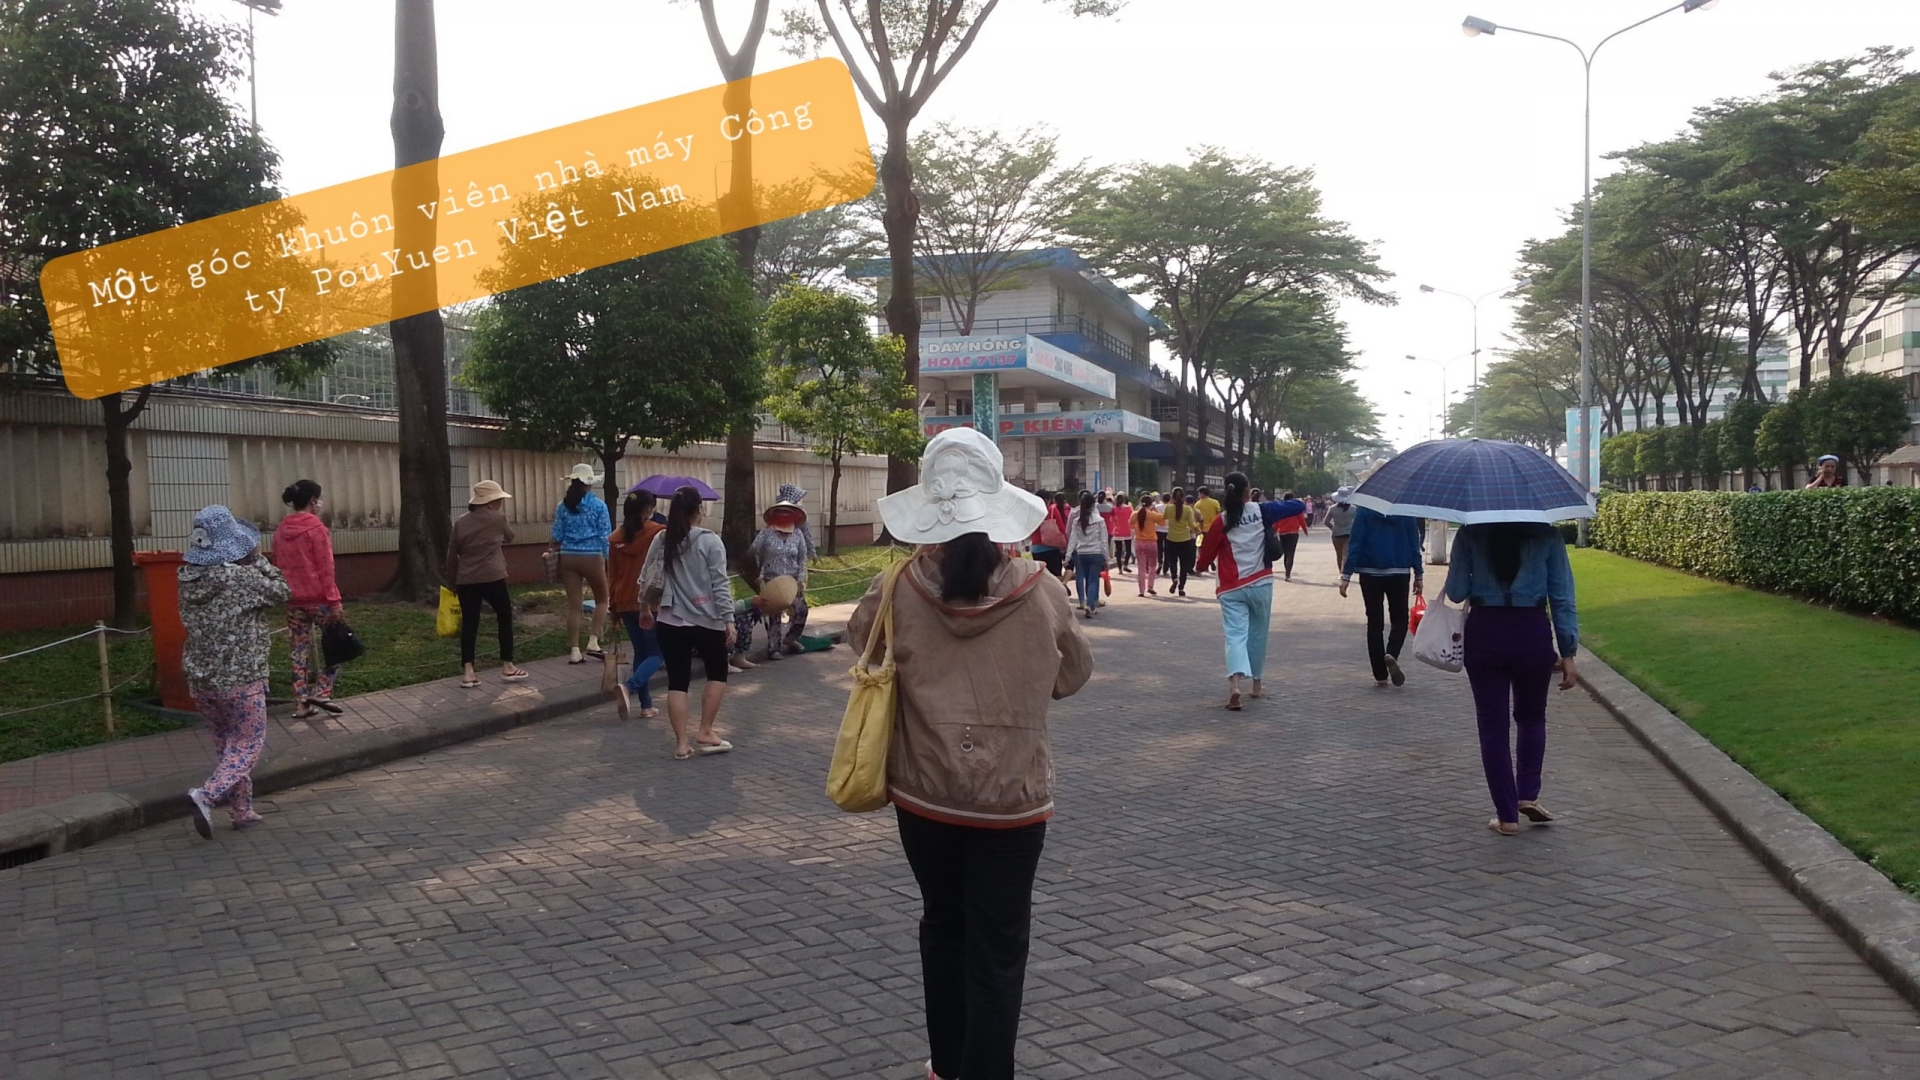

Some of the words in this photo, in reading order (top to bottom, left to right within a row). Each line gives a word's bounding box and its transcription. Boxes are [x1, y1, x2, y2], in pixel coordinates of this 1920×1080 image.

[968, 337, 1022, 353] NÓNG
[977, 354, 1018, 366] 7137
[1023, 415, 1084, 433] KIẾN
